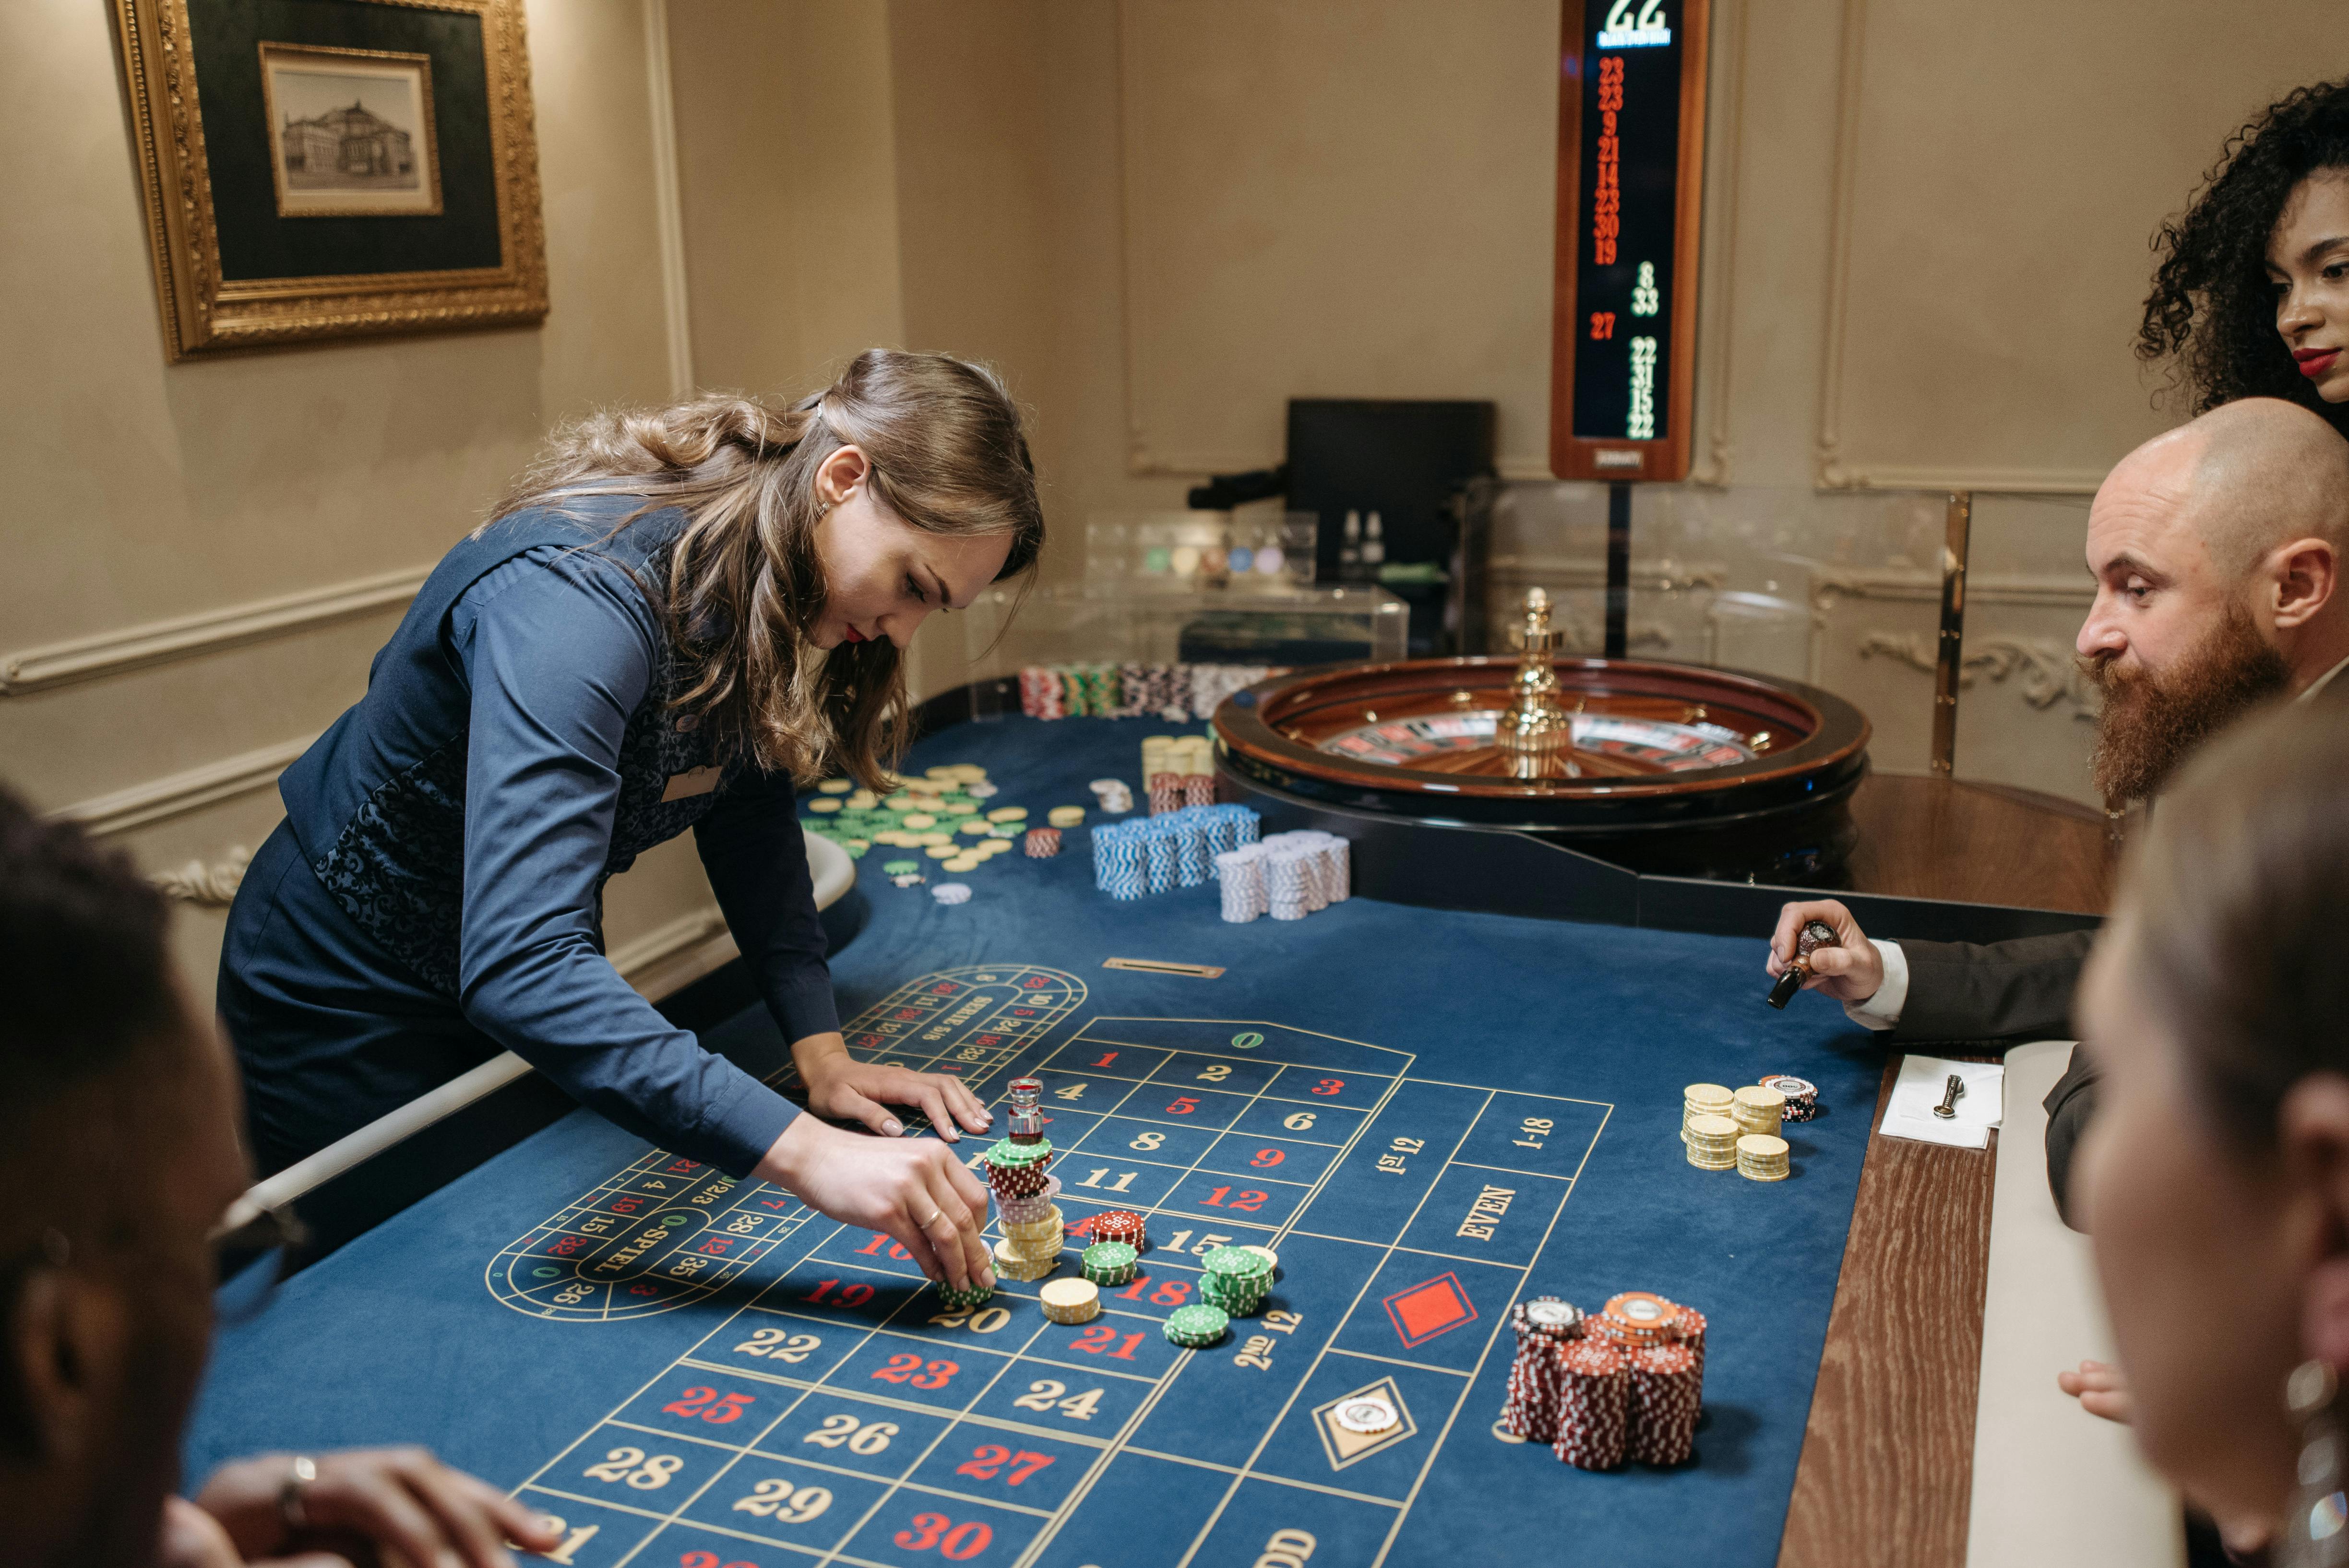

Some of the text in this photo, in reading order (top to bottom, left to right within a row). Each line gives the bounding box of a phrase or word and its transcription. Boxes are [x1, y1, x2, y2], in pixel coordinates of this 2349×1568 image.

[1598, 135, 1620, 162] 21
[1595, 238, 1617, 265] 19
[1638, 261, 1654, 288] 8
[1632, 286, 1659, 317] 33
[1590, 312, 1616, 340] 27
[1630, 336, 1657, 365] 22
[1631, 363, 1655, 389] 31
[1630, 387, 1654, 415] 15
[1627, 414, 1655, 440] 22
[956, 1047, 986, 1060] 33
[1231, 1032, 1264, 1049] 0
[1090, 1052, 1119, 1067] 1
[1197, 1065, 1232, 1081] 2
[1054, 1083, 1087, 1100] 4
[1312, 1079, 1344, 1095] 3
[1166, 1097, 1200, 1114] 5
[1283, 1112, 1316, 1130] 6
[1512, 1117, 1554, 1150] 1-18
[1129, 1131, 1166, 1151] 8
[1390, 1137, 1425, 1154] 12
[965, 1152, 986, 1170] 1
[1250, 1149, 1285, 1167] 9
[643, 1180, 666, 1189] 4
[1076, 1167, 1137, 1192] 11
[611, 1197, 644, 1212] 19
[761, 1200, 786, 1210] 7
[1200, 1186, 1268, 1211] 12
[580, 1216, 615, 1233] 15
[727, 1214, 763, 1233] 28
[1456, 1185, 1516, 1241] EVEN
[547, 1236, 587, 1255] 32
[594, 1215, 688, 1272] 0-SPIEL
[698, 1236, 733, 1254] 12
[1157, 1230, 1232, 1256] 15
[532, 1266, 561, 1278] 0
[669, 1257, 708, 1277] 35
[553, 1283, 595, 1304] 26
[630, 1284, 657, 1296] 3
[799, 1279, 875, 1307] 19
[1116, 1276, 1192, 1306] 18
[929, 1304, 1011, 1333] 20
[734, 1328, 822, 1364] 22
[1069, 1326, 1145, 1360] 21
[1234, 1309, 1303, 1371] 2ND 12
[872, 1354, 959, 1389] 23
[663, 1387, 755, 1423] 25
[1014, 1379, 1104, 1420] 24
[803, 1414, 899, 1455] 26
[584, 1447, 684, 1490] 28
[957, 1445, 1055, 1485] 27
[733, 1479, 833, 1523] 29
[895, 1513, 992, 1559] 30
